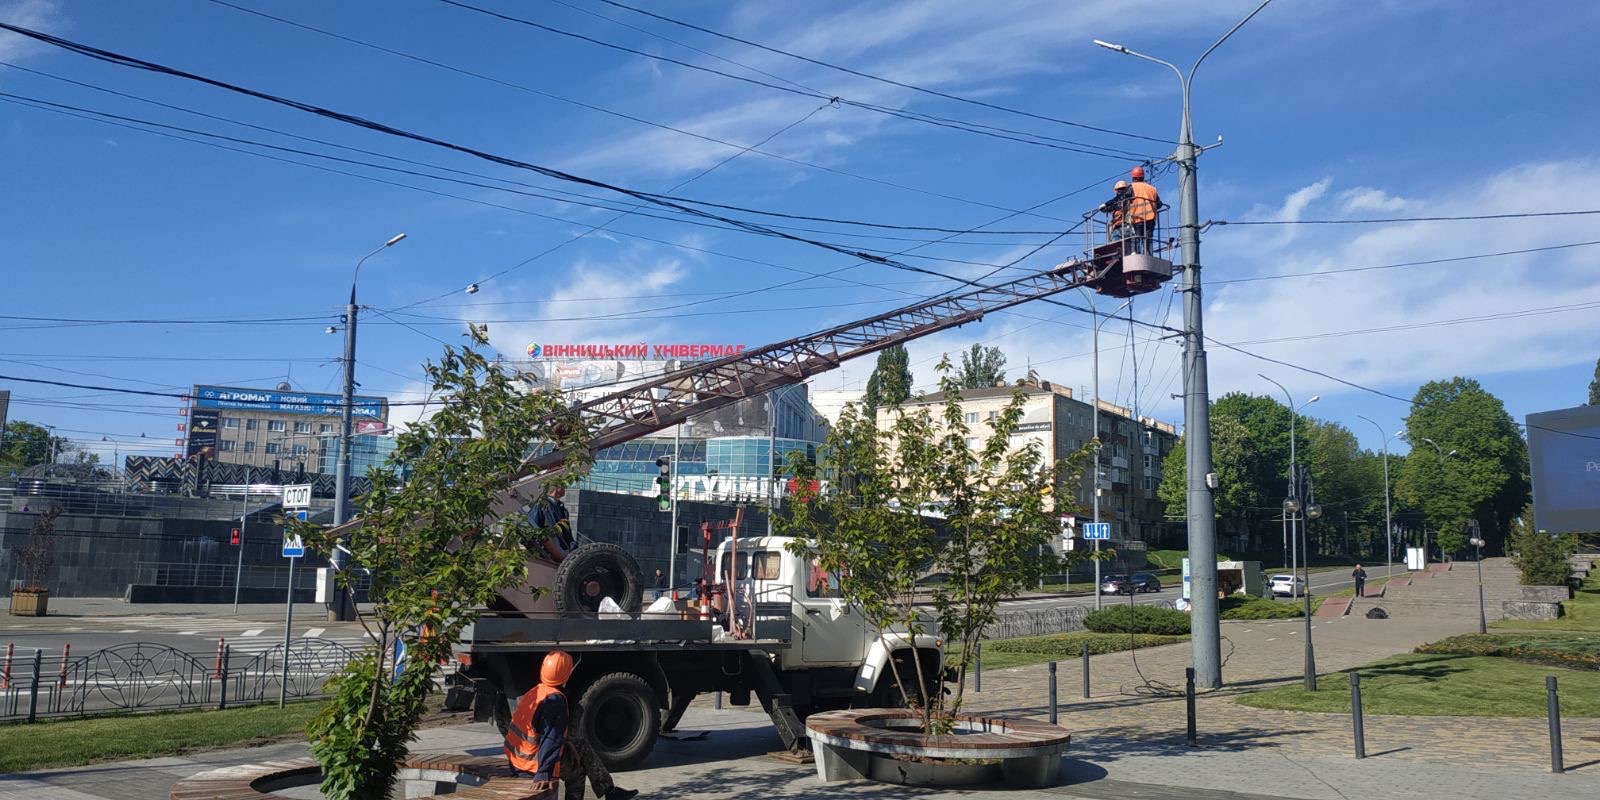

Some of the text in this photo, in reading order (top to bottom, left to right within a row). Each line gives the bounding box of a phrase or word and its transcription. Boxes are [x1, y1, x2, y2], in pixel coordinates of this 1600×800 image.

[542, 341, 746, 357] ВІННИЦЬКИЙ УНІВЕРМАГ
[218, 392, 272, 402] АГРОМАТ
[280, 395, 308, 403] НОВИЙ
[280, 403, 315, 411] МАГАЗИН
[287, 488, 309, 503] СТОП
